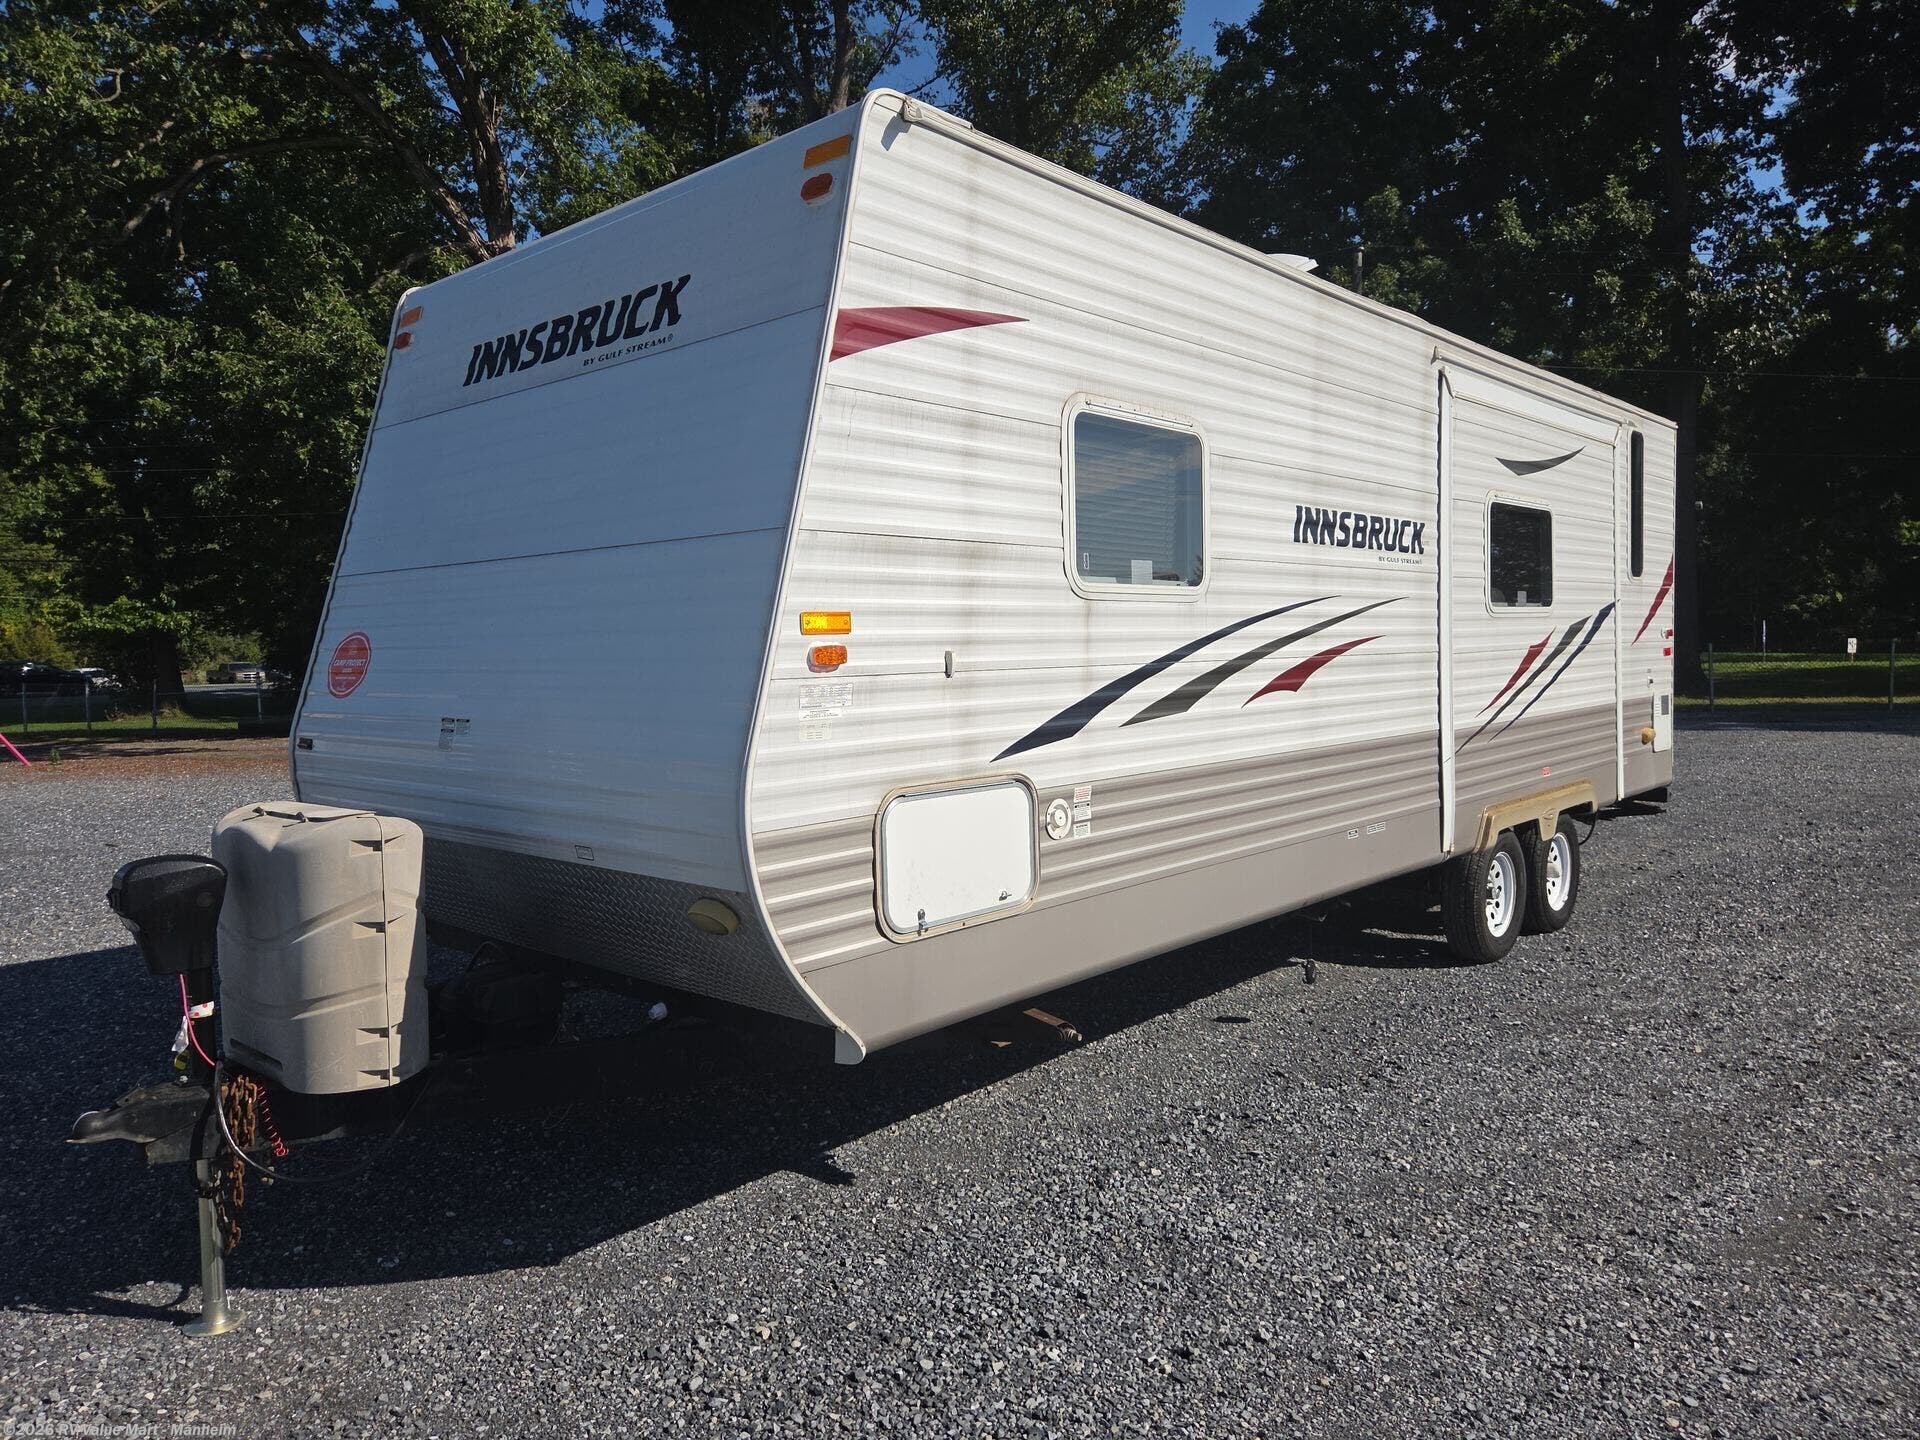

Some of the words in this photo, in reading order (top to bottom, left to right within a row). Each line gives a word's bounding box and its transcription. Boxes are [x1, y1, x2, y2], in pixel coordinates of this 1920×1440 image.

[463, 274, 691, 387] INNSBRUCK
[582, 356, 596, 367] BY
[597, 348, 624, 363] GULF
[1294, 505, 1425, 555] INNSBRUCK
